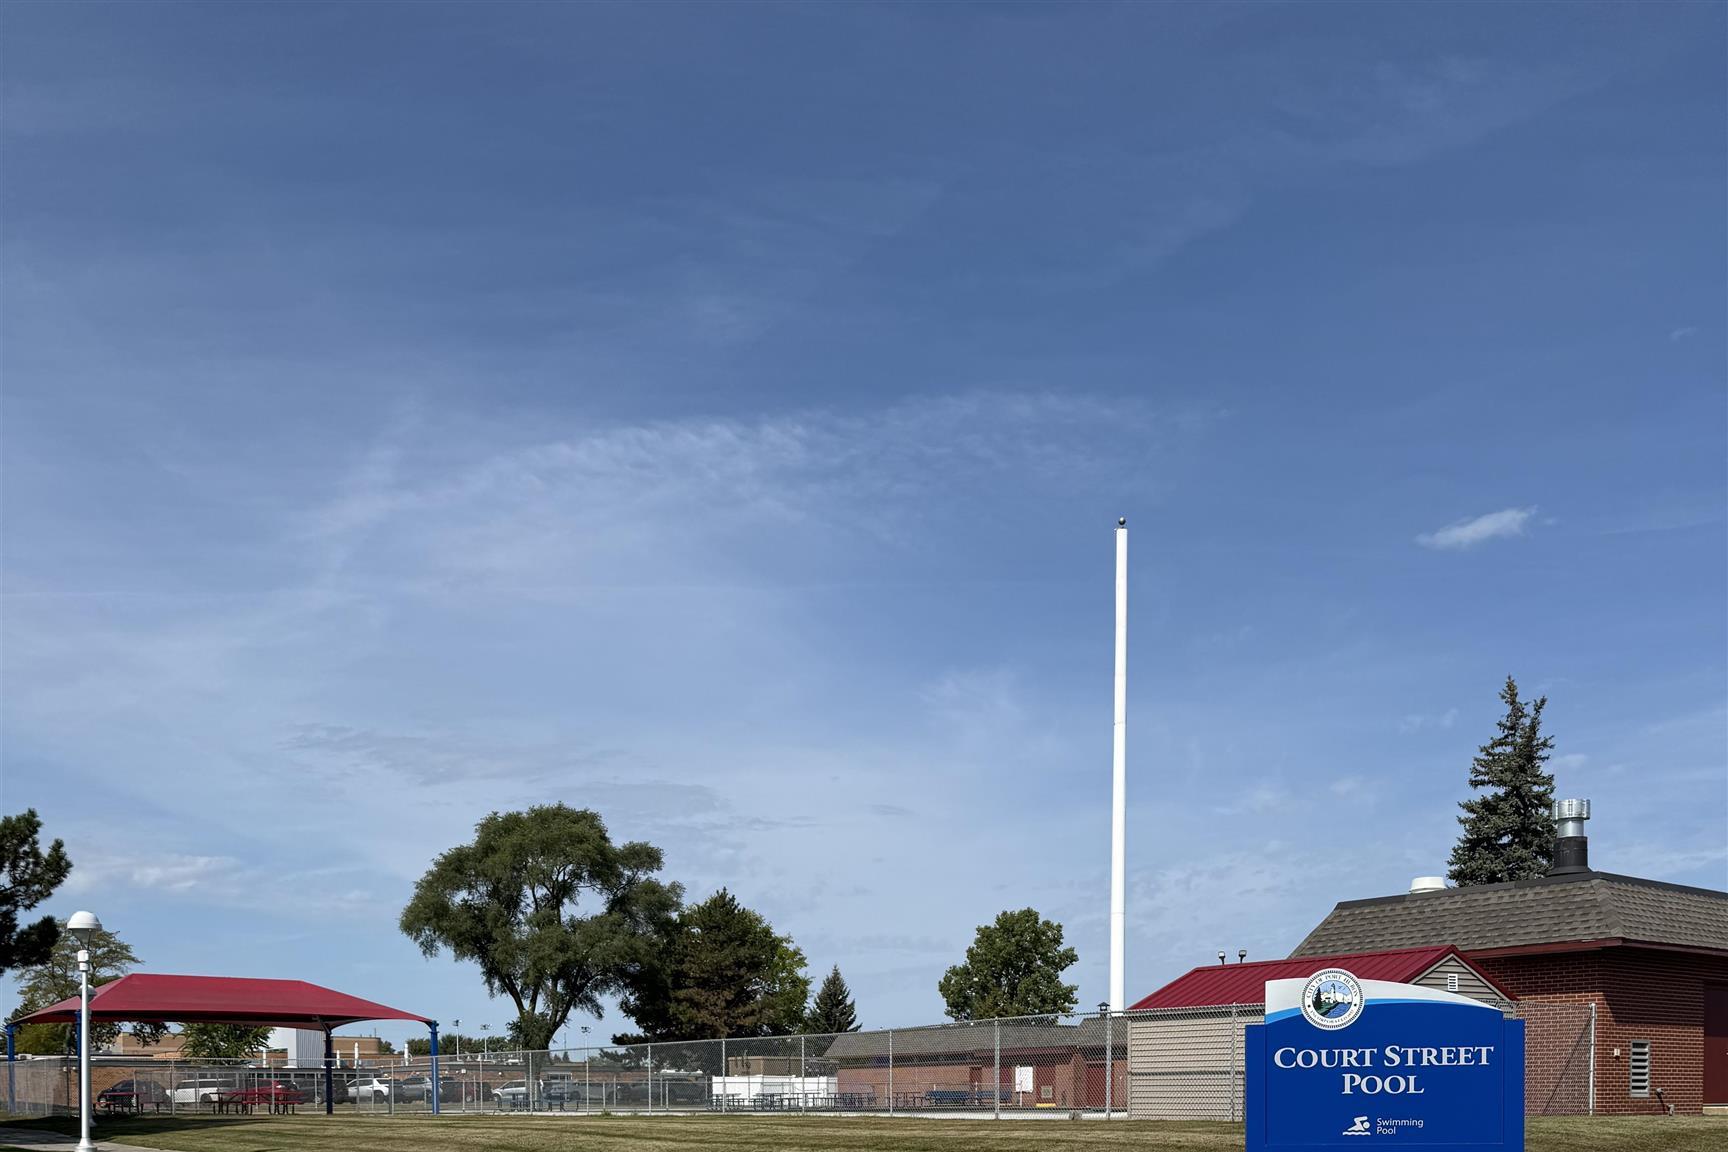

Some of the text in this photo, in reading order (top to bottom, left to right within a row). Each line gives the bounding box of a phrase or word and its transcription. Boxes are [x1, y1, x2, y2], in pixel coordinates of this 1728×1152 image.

[1274, 1046, 1494, 1069] COURT STREET
[1342, 1074, 1424, 1094] POOL
[1376, 1118, 1424, 1128] Swimming
[1376, 1126, 1396, 1135] Pool
